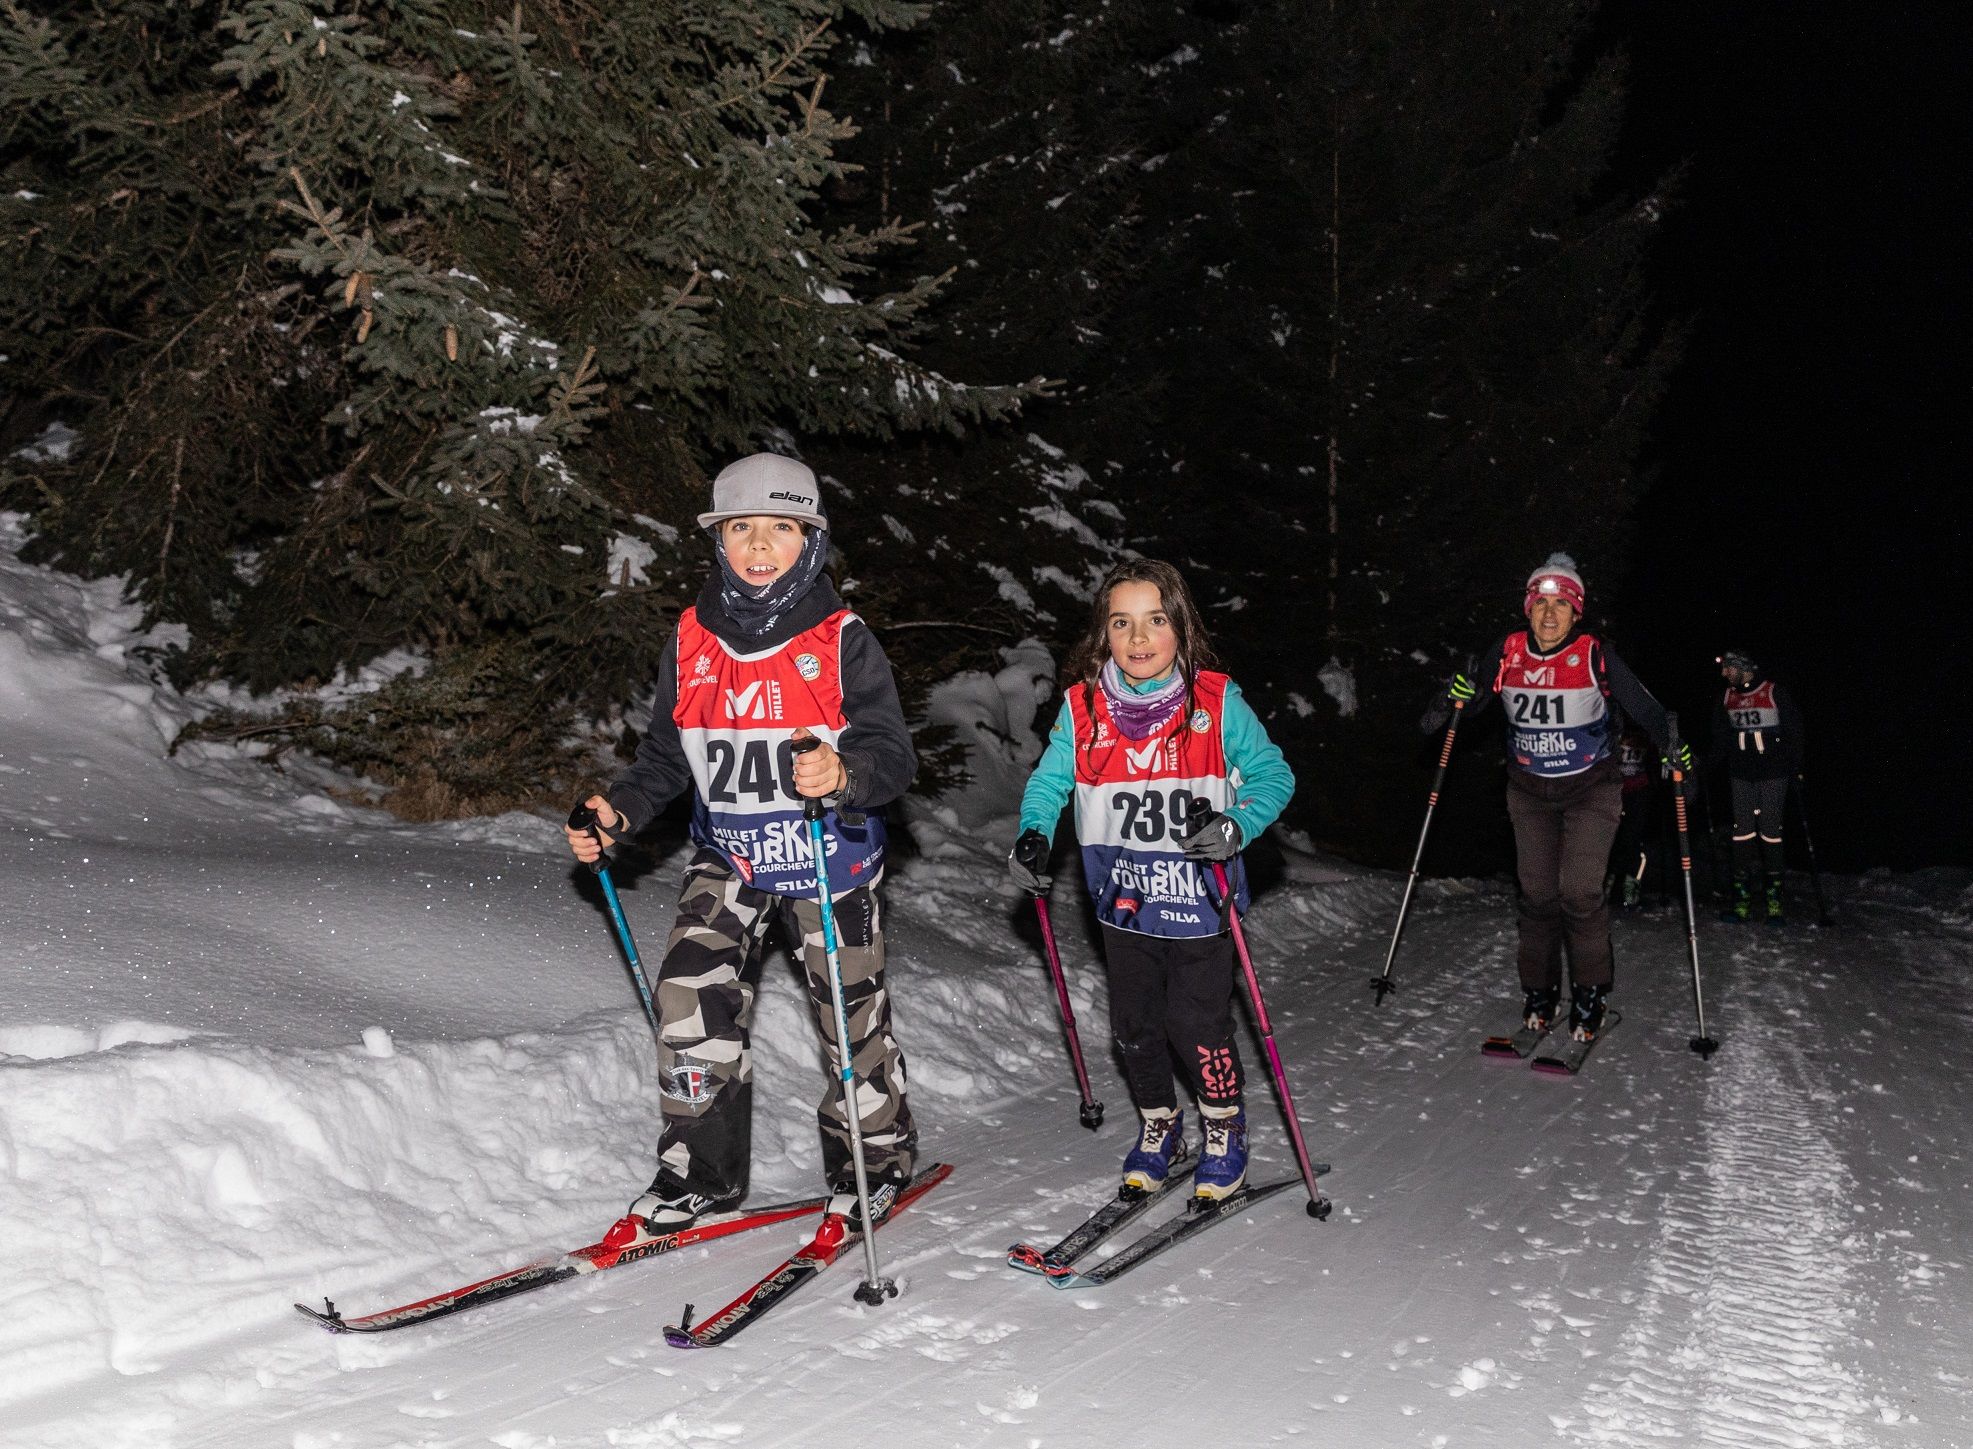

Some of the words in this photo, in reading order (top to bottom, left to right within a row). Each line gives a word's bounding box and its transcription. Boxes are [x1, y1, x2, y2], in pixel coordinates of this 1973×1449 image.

[768, 491, 814, 506] elan
[771, 680, 783, 720] MILLET
[1513, 693, 1565, 724] 241
[1514, 737, 1577, 753] TOURING
[1539, 732, 1565, 744] SKI
[712, 826, 758, 842] MILLET
[753, 860, 815, 874] COURCHEVE
[1152, 860, 1193, 879] SKI
[775, 880, 818, 892] SILV
[1143, 894, 1200, 906] COURCHEVEL
[1159, 909, 1201, 924] SILVA
[614, 1236, 679, 1264] ATOMIC
[694, 1302, 751, 1342] ATOMIC
